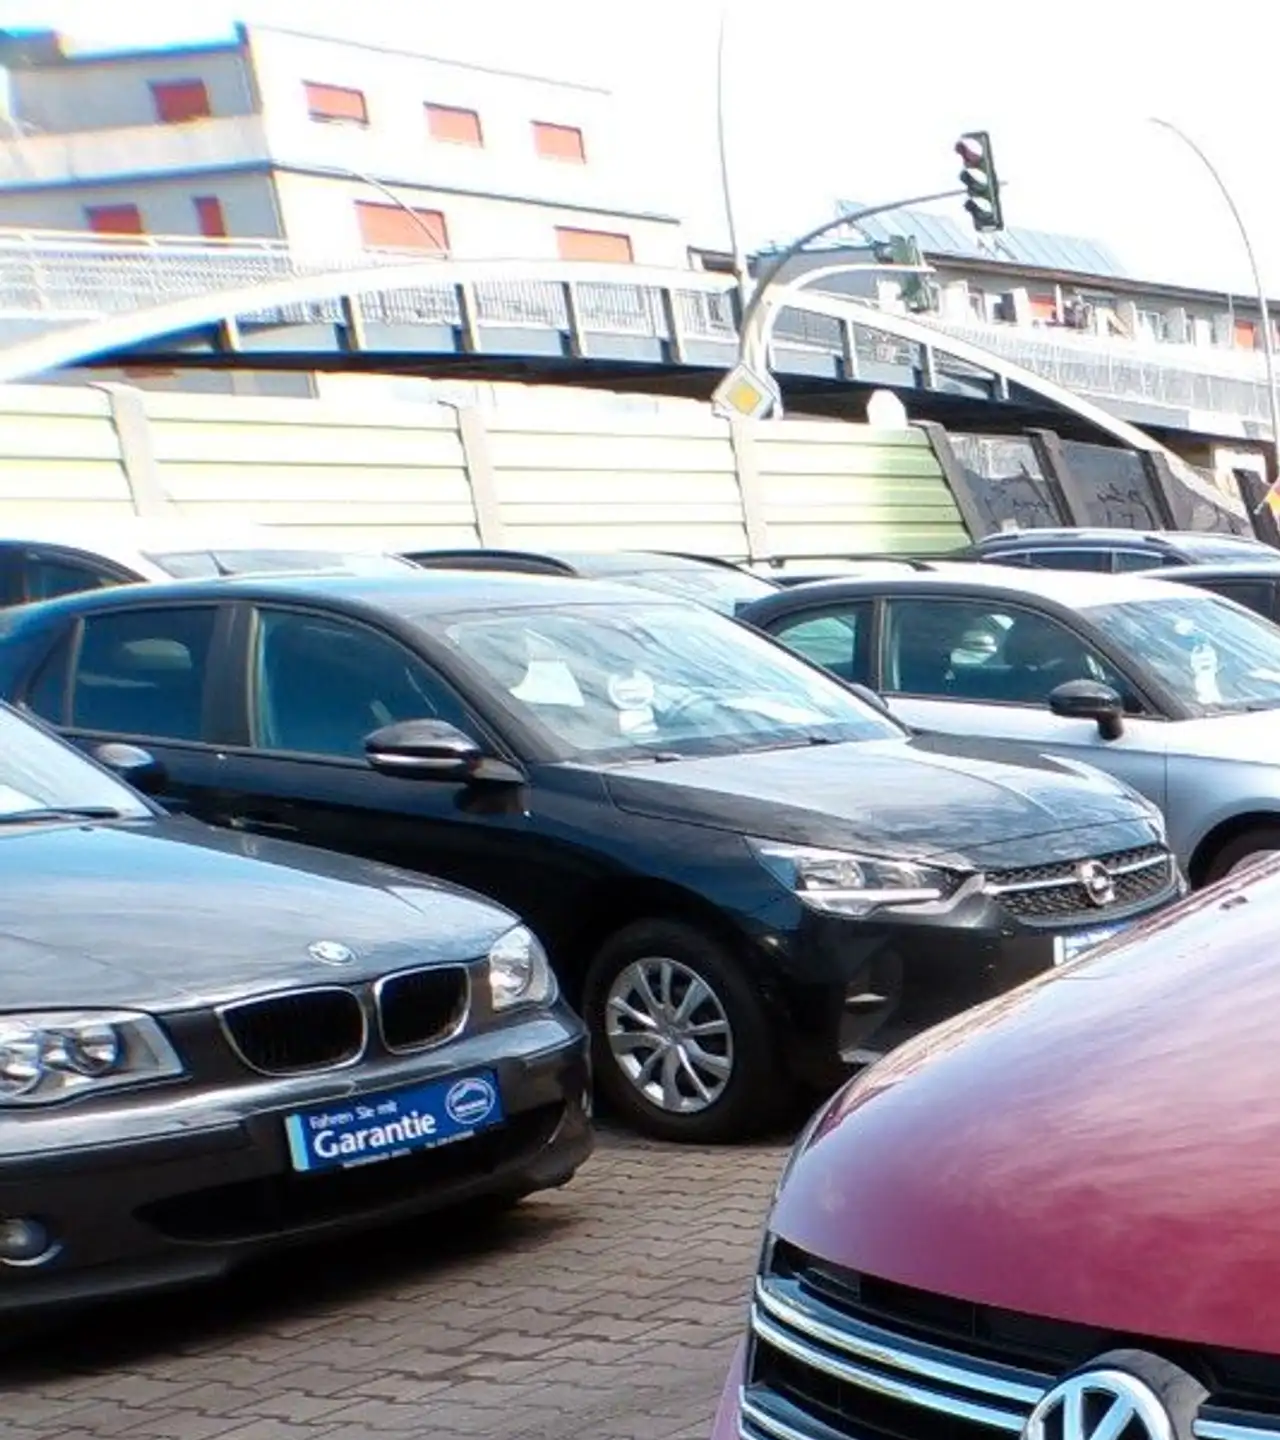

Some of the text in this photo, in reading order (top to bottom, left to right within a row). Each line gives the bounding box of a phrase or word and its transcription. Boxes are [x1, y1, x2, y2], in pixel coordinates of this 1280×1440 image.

[310, 1099, 398, 1129] Fahren Sie mit
[313, 1111, 437, 1158] Garantie
